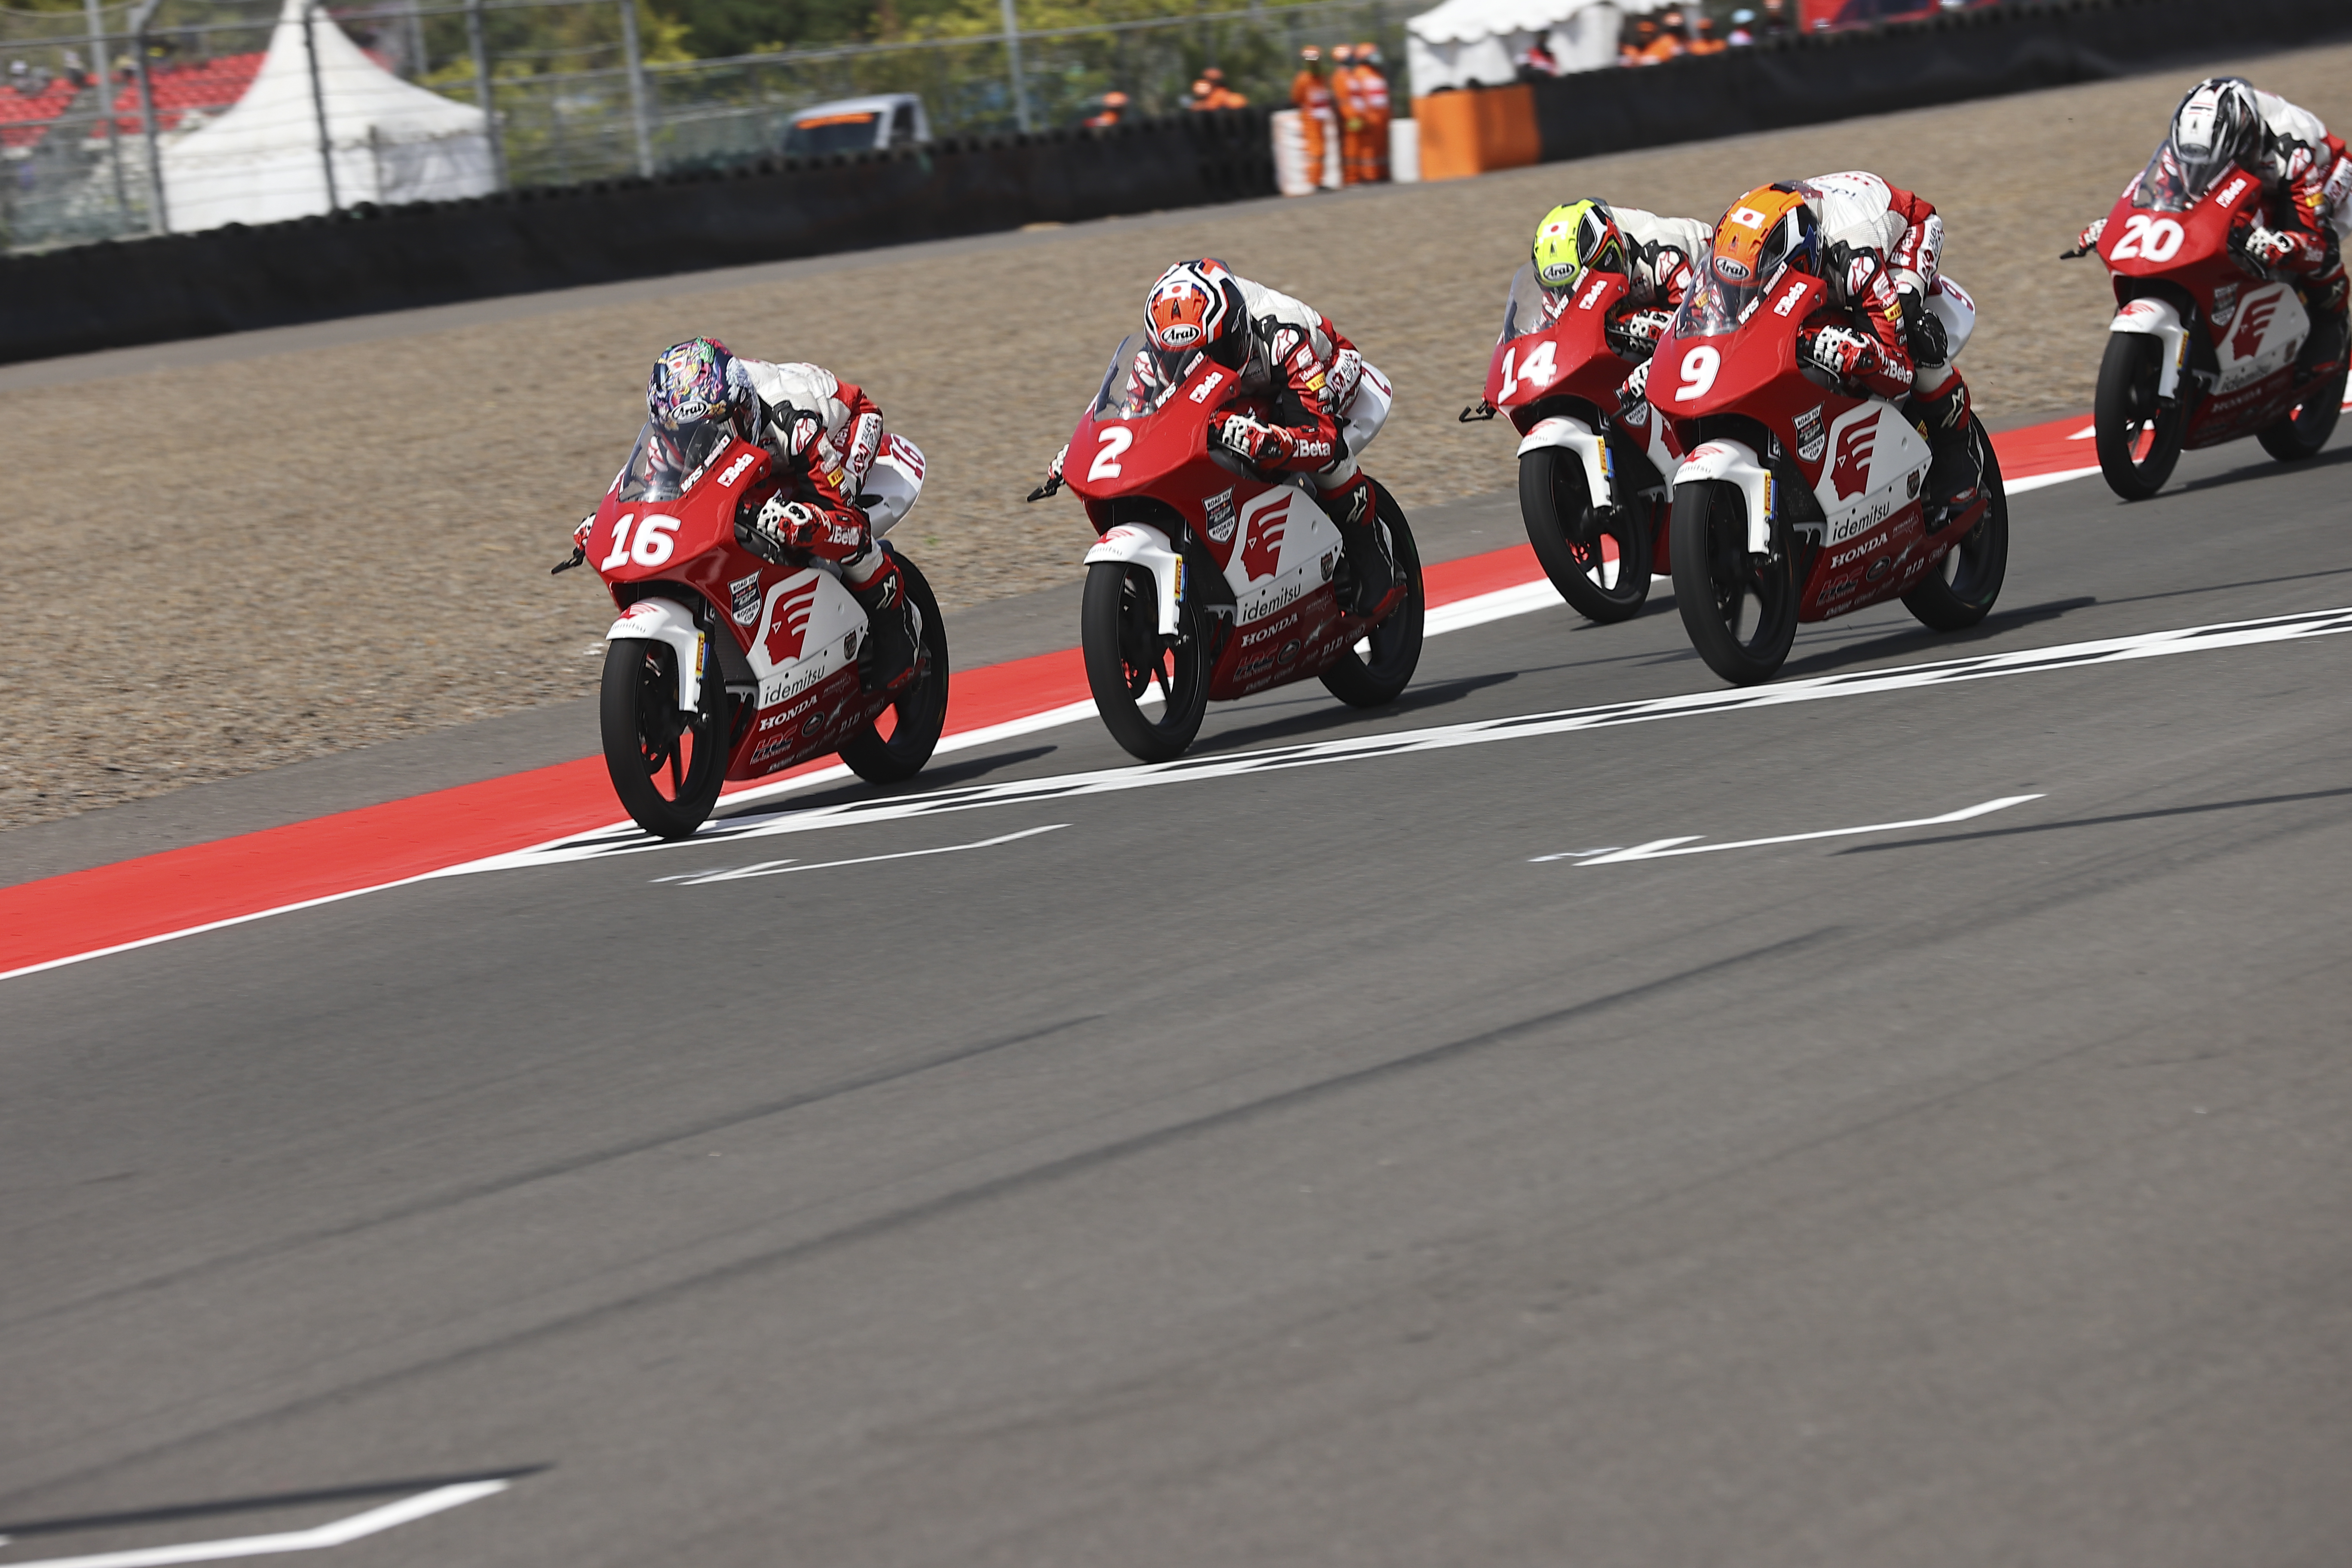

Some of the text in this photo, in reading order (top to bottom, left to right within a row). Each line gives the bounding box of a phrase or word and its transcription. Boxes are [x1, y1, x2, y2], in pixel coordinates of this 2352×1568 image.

[2109, 214, 2185, 263] 20
[1547, 264, 1569, 276] Arai
[1719, 259, 1743, 275] Arai
[1779, 281, 1808, 309] Beta
[1942, 280, 1974, 311] 9
[1165, 327, 1193, 342] Arai
[1194, 371, 1224, 396] Beta
[1497, 340, 1557, 404] 14
[1675, 345, 1721, 402] 9
[1889, 359, 1913, 385] Beta
[675, 403, 701, 418] Arai
[1798, 414, 1811, 426] ROAD
[892, 434, 925, 481] 16
[1087, 426, 1133, 483] 2
[1299, 438, 1331, 458] Beta
[1803, 438, 1823, 455] ROOKIES
[1810, 448, 1819, 458] CUP
[724, 453, 755, 482] Beta
[1207, 496, 1221, 508] ROAD
[1213, 519, 1234, 536] ROOKIES
[1220, 530, 1229, 539] CUP
[1833, 501, 1890, 542] idemitsu
[600, 513, 681, 572] 16
[1830, 532, 1888, 570] HONDA
[733, 580, 747, 591] ROAD
[749, 575, 756, 583] TO
[737, 602, 759, 619] ROOKIES
[1243, 583, 1301, 622] idemitsu
[744, 612, 754, 622] CUP
[1241, 612, 1298, 648] HONDA
[764, 665, 825, 705] idemitsu
[759, 694, 817, 732] HONDA
